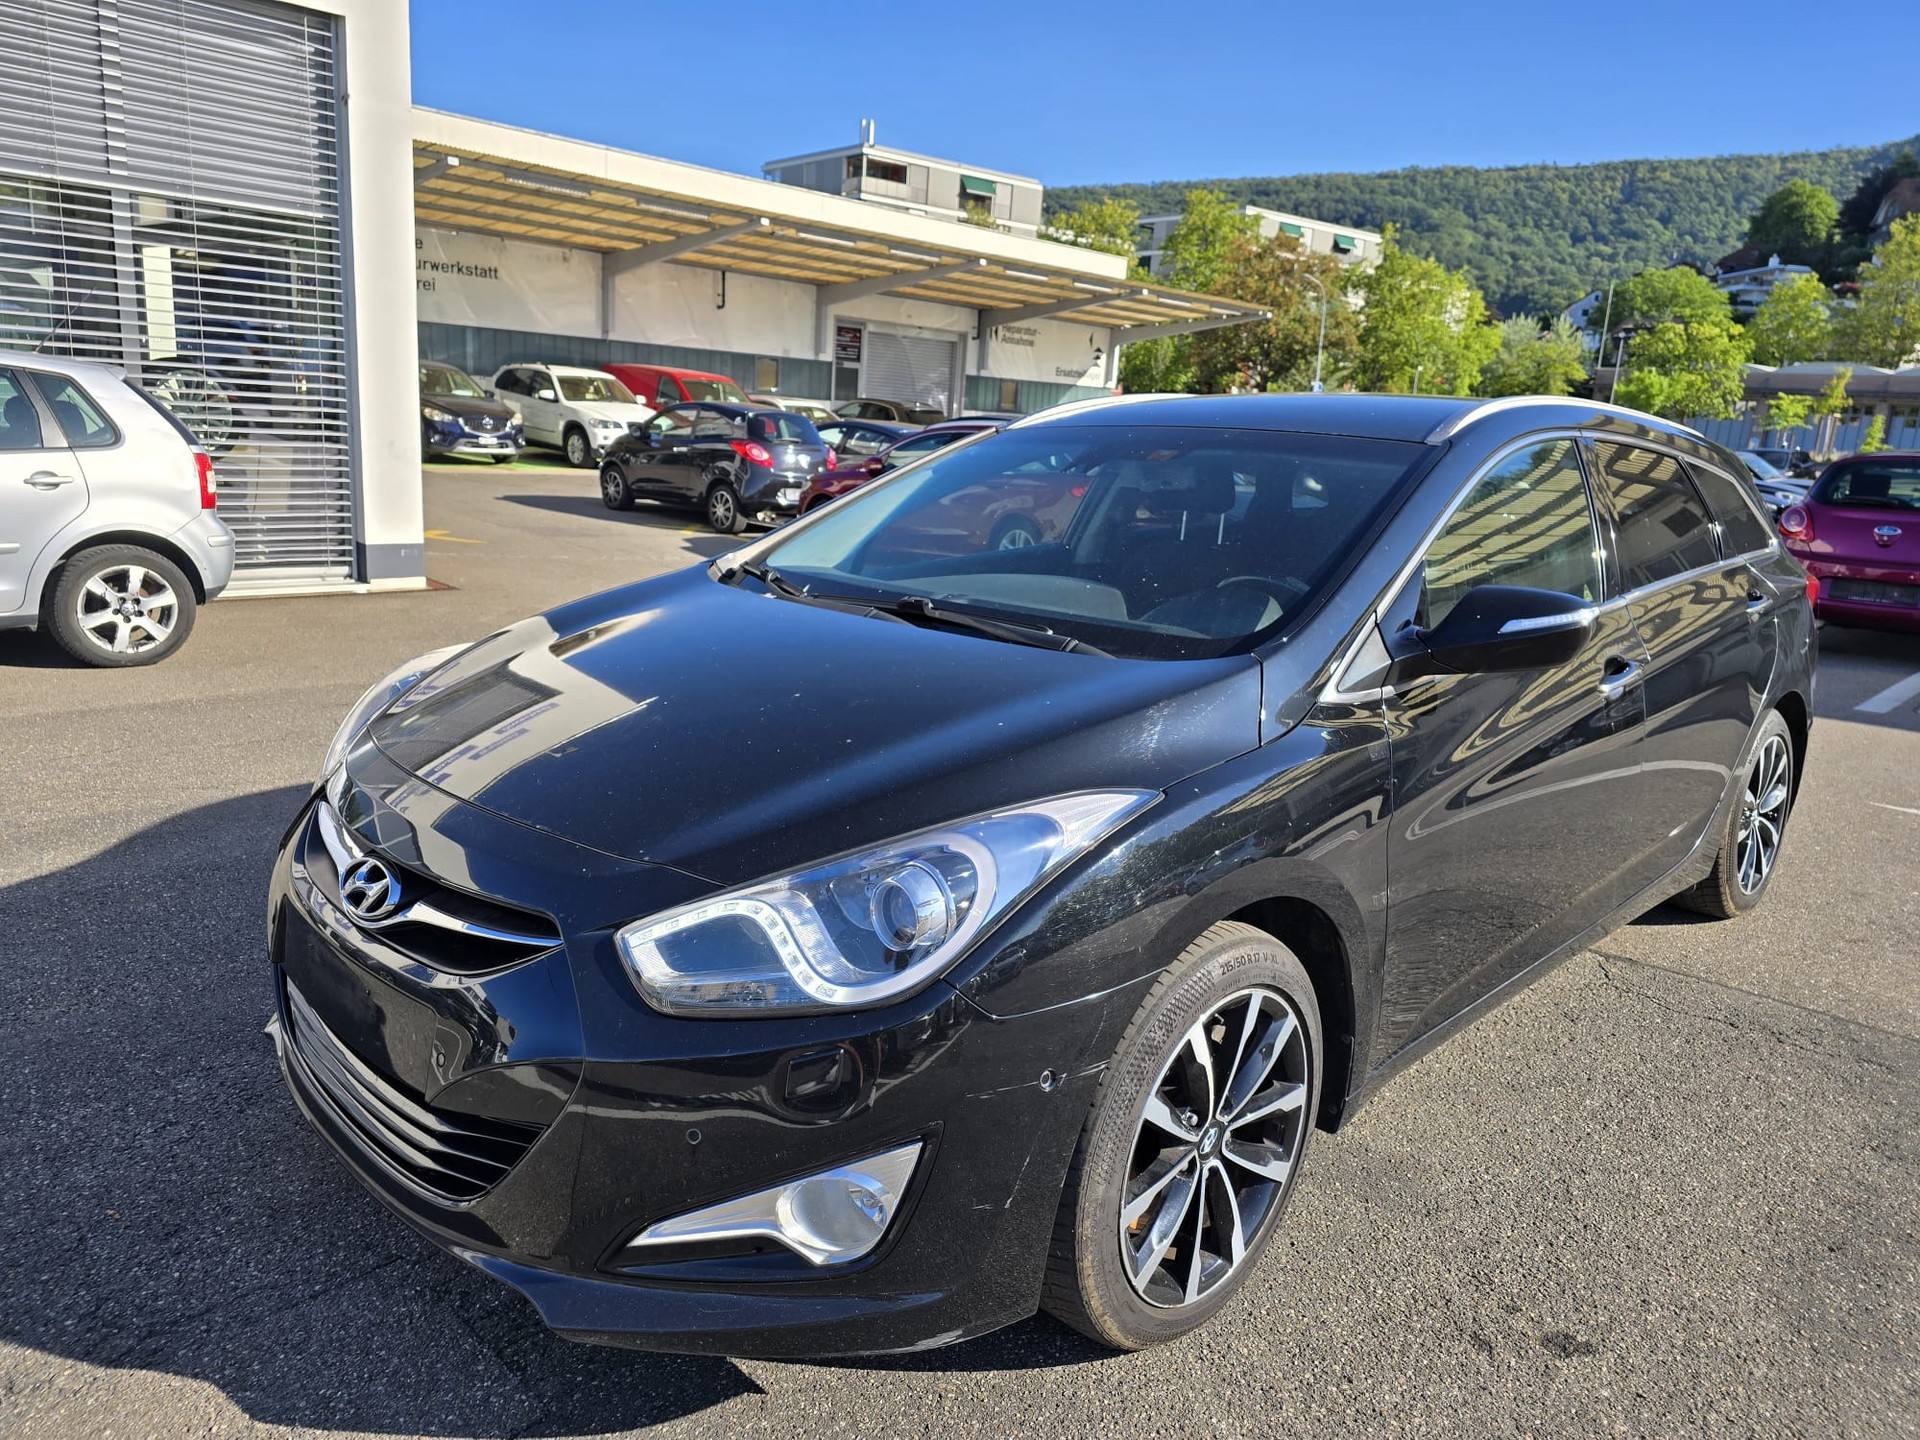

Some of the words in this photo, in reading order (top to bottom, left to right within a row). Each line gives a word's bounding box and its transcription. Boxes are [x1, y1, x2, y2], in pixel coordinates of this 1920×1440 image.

[1001, 333, 1035, 348] Annahme
[1220, 954, 1246, 976] 215/50
[1247, 953, 1253, 964] R
[1253, 952, 1260, 963] 17
